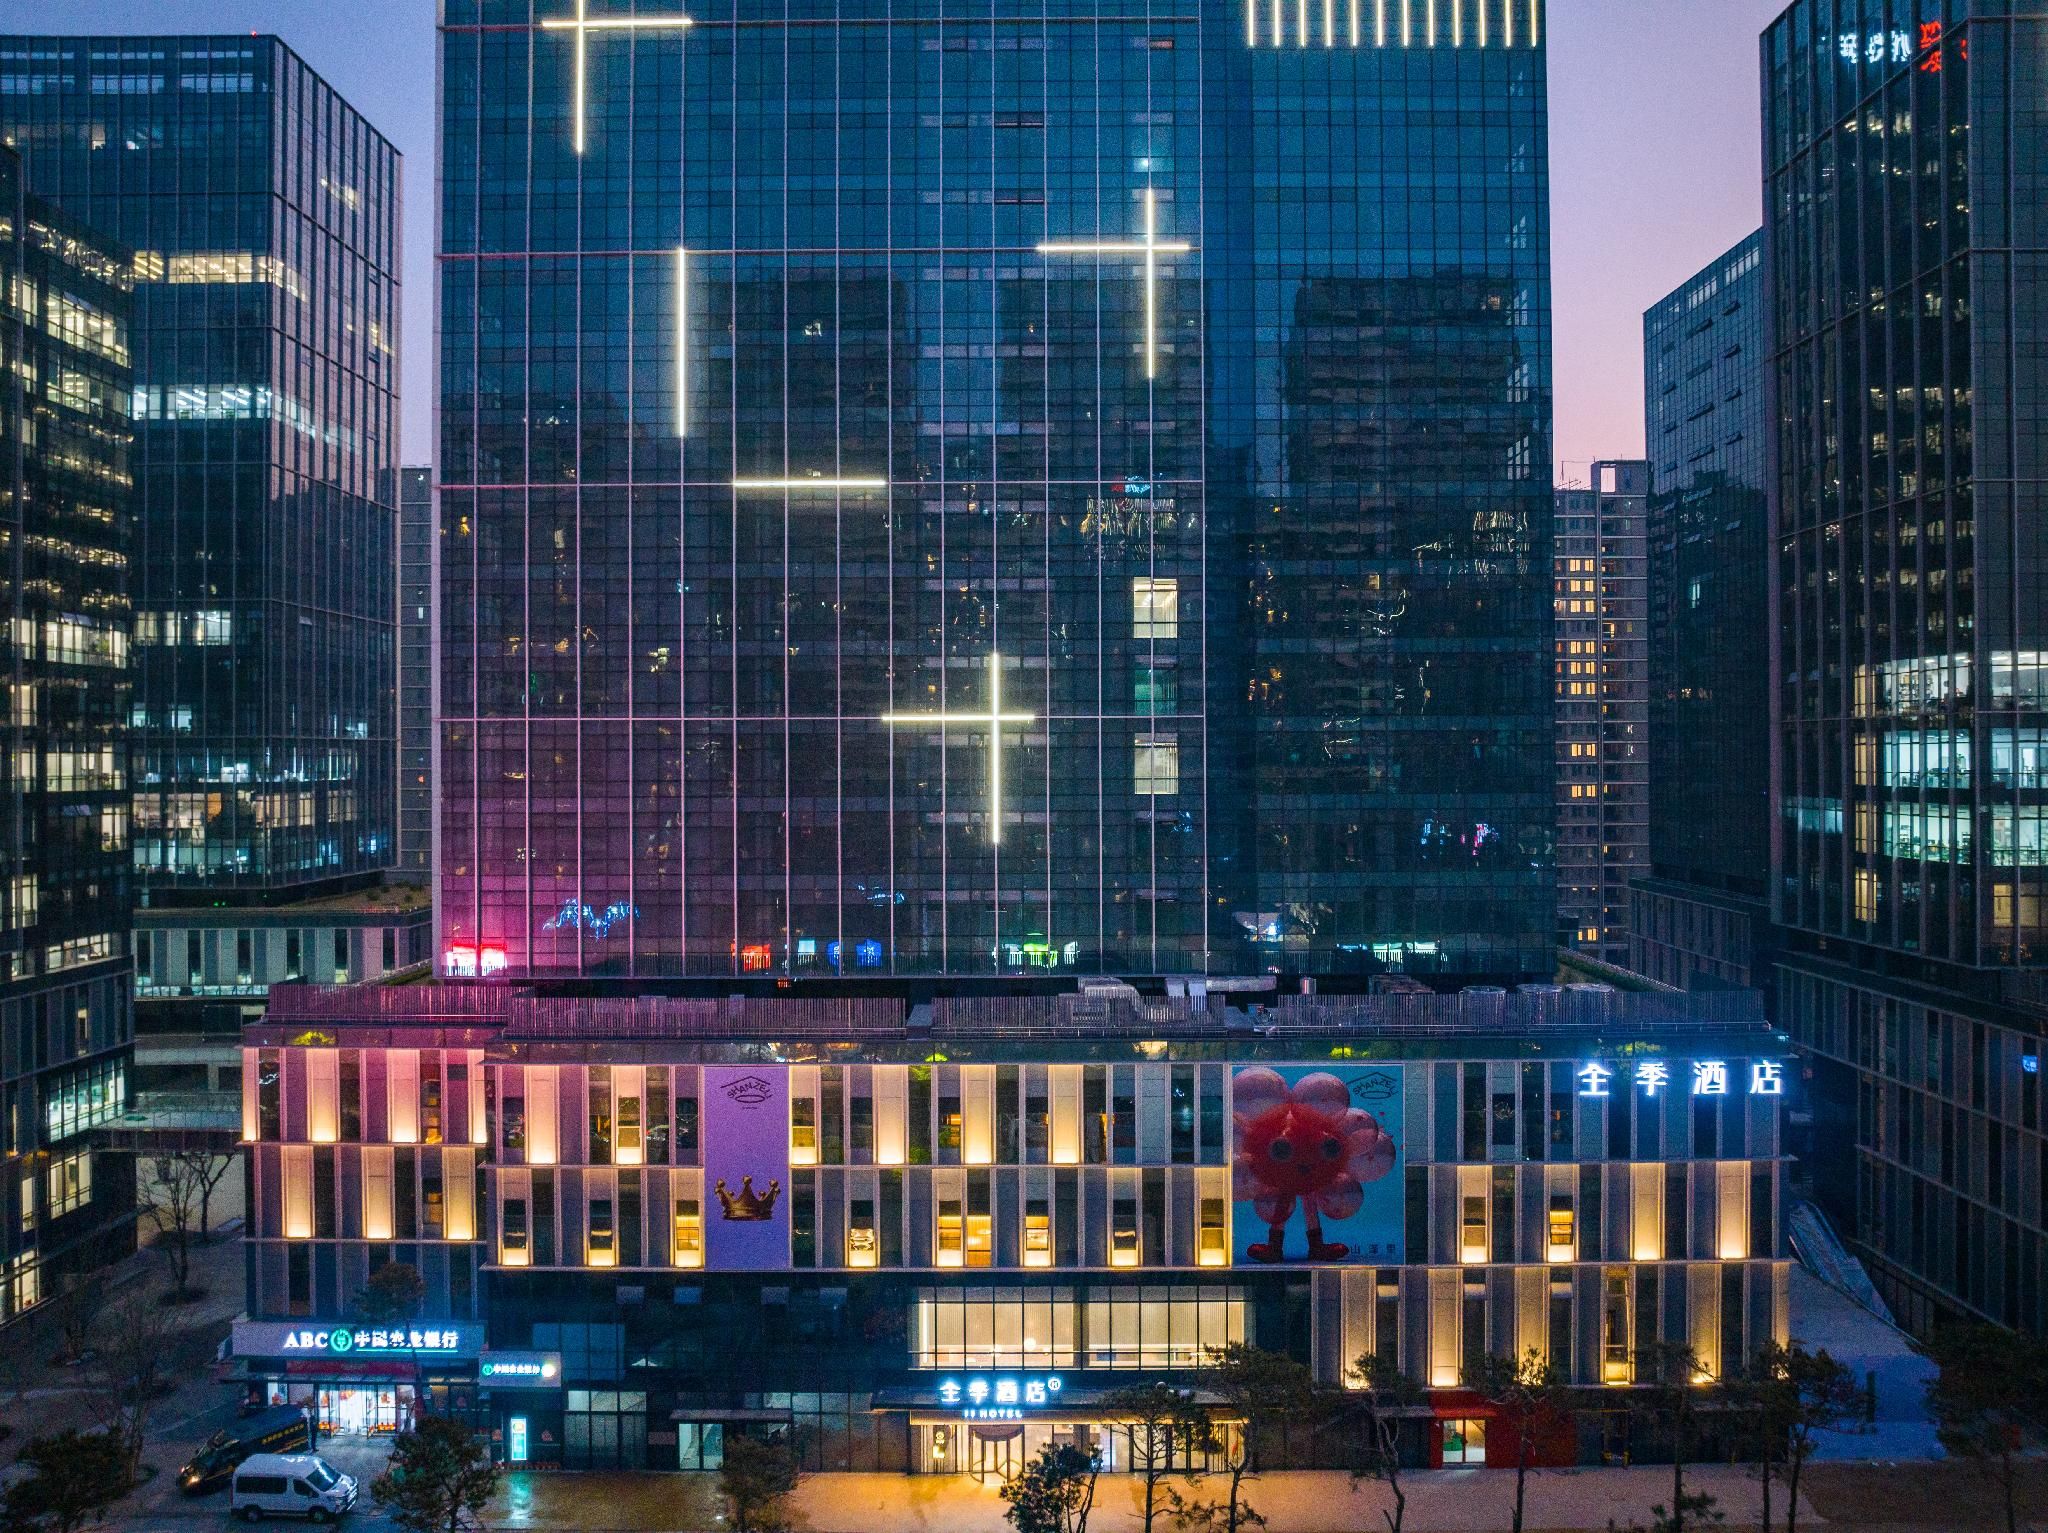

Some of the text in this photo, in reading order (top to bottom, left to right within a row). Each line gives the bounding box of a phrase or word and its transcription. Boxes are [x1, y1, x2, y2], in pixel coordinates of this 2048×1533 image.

[1577, 1060, 1783, 1097] 全季酒店
[283, 1332, 328, 1348] ABC
[940, 1381, 1046, 1404] 全季酒店
